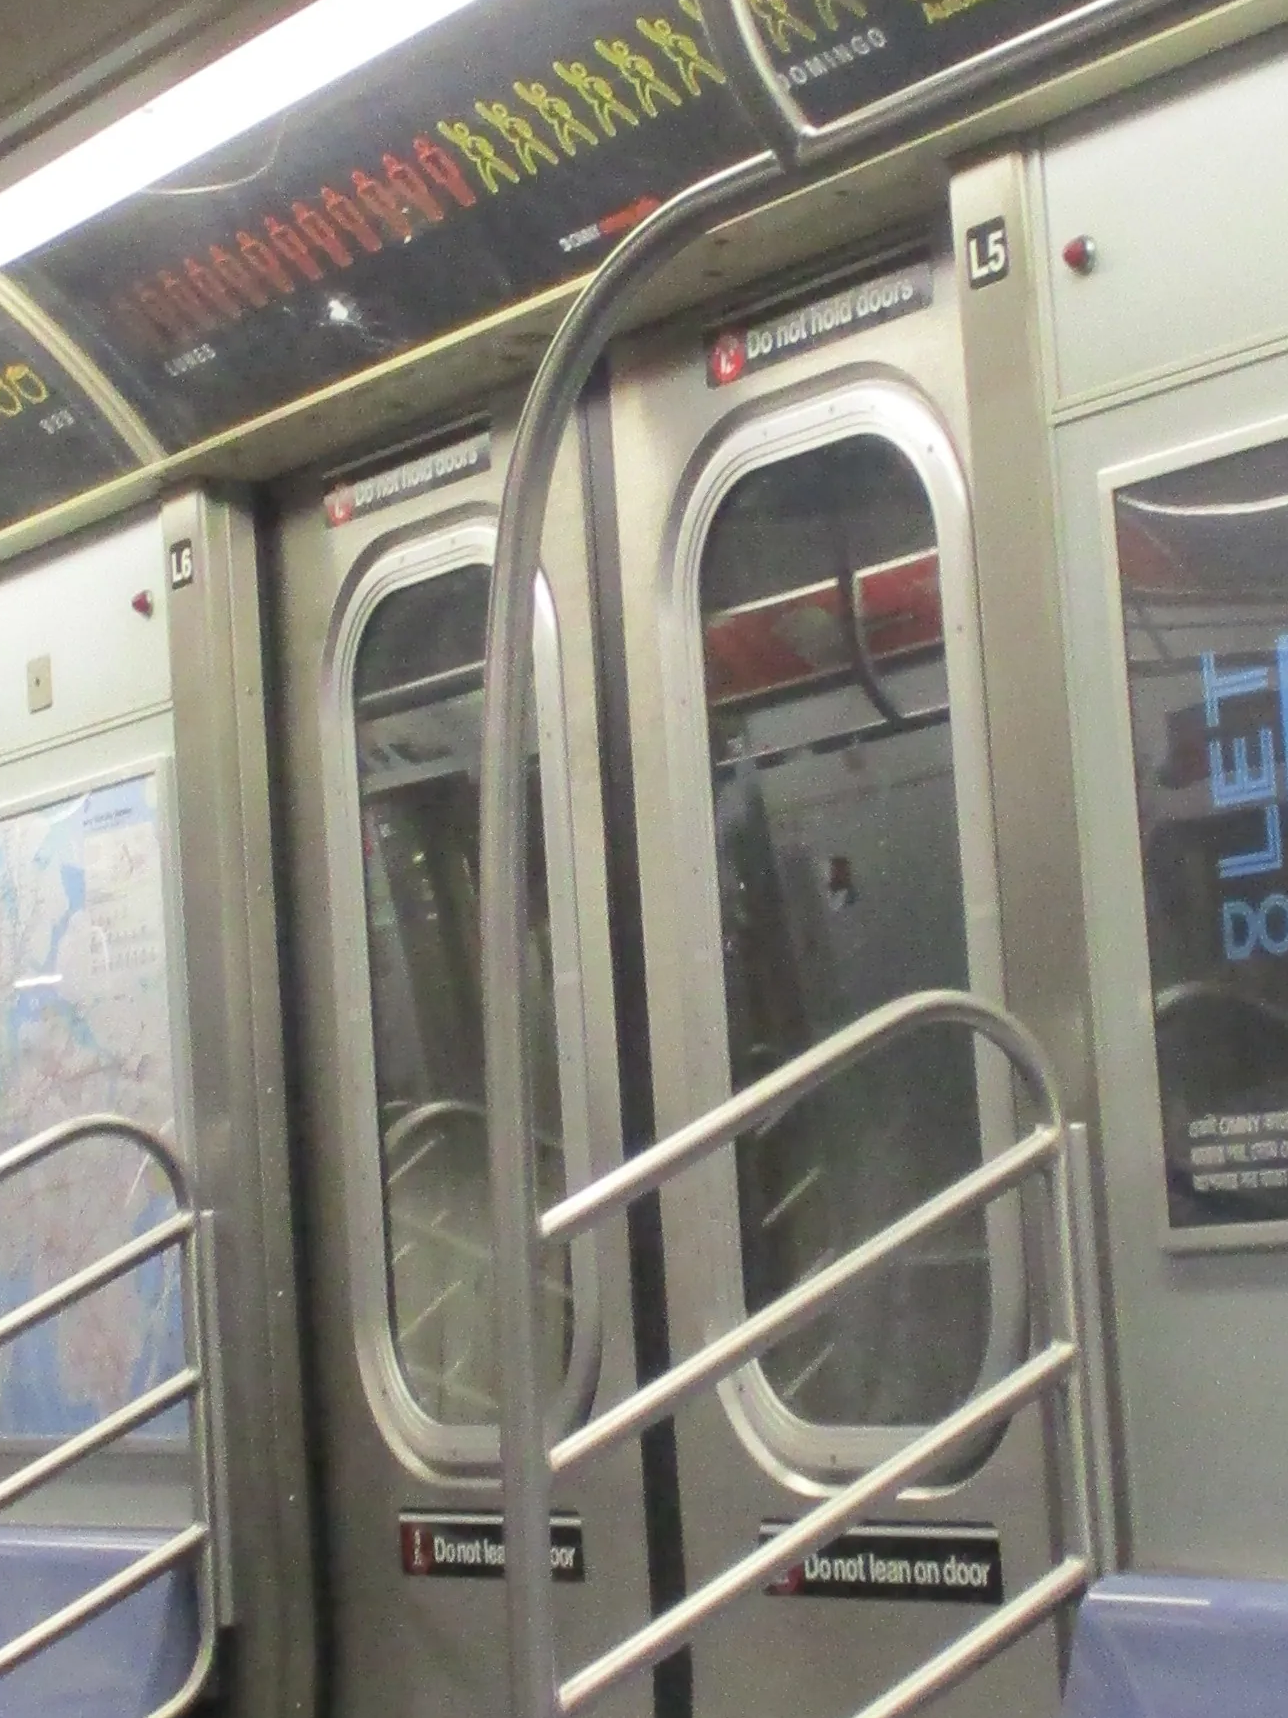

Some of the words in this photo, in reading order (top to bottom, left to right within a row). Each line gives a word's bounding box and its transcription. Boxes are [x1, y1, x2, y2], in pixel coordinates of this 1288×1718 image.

[968, 229, 1007, 280] L5
[745, 326, 774, 361] Do
[776, 312, 808, 348] not
[811, 294, 852, 338] hold
[856, 277, 914, 317] doors
[171, 547, 192, 583] L6
[1201, 650, 1284, 880] LET
[434, 1535, 454, 1563] Do
[457, 1539, 482, 1565] not
[804, 1554, 831, 1581] Do
[833, 1554, 866, 1583] not
[869, 1553, 911, 1584] lean
[914, 1562, 940, 1584] on
[943, 1555, 991, 1587] door
